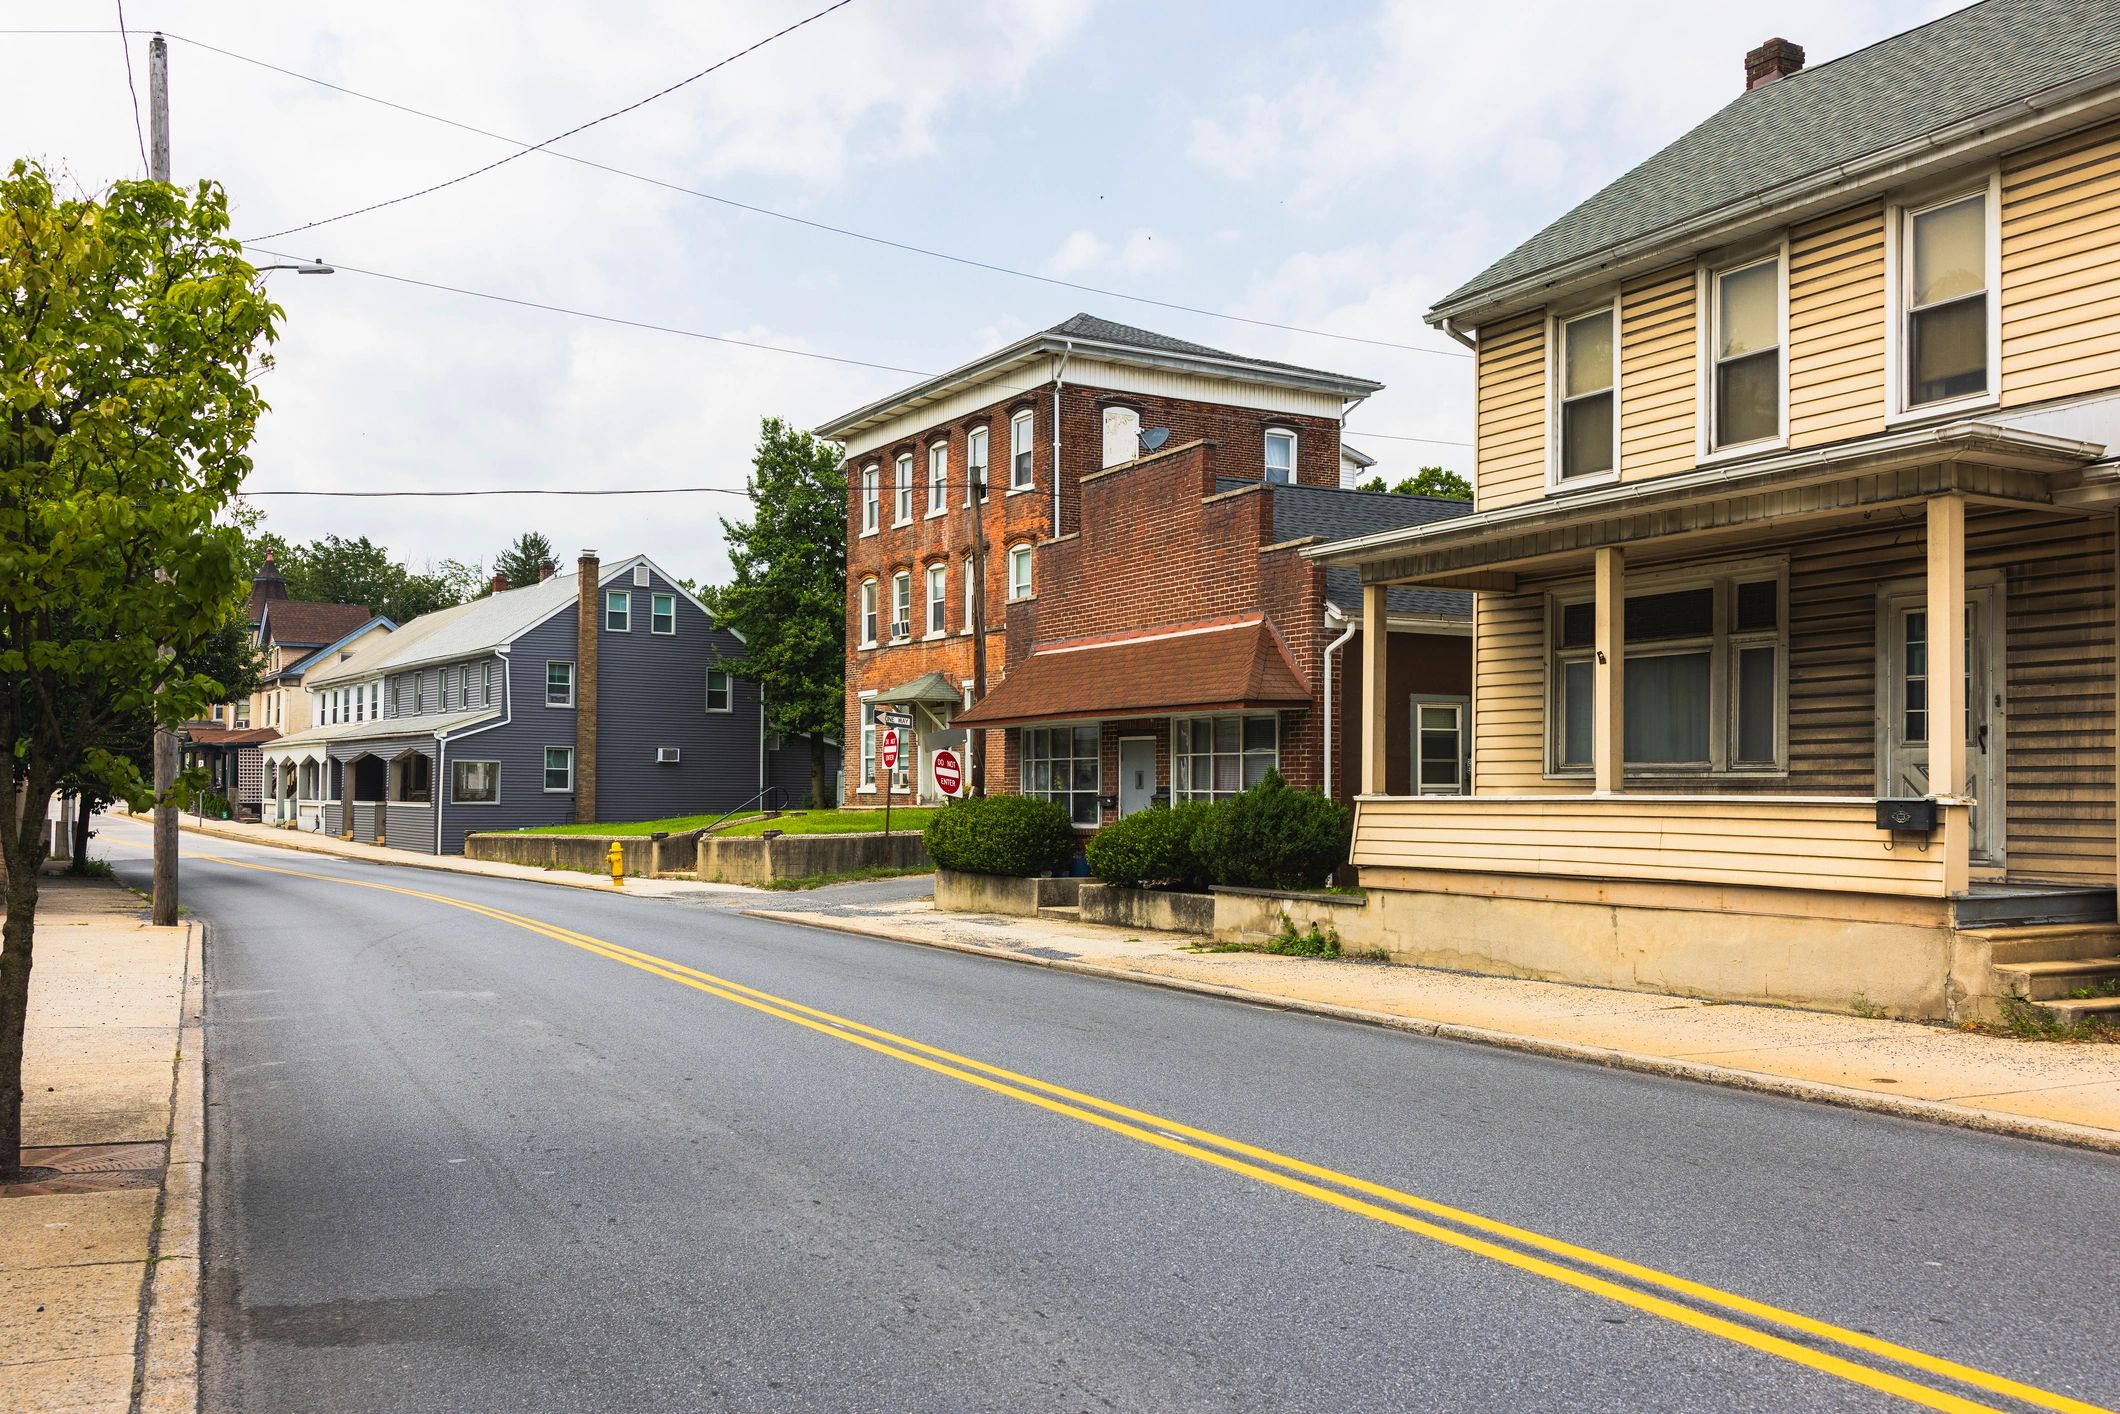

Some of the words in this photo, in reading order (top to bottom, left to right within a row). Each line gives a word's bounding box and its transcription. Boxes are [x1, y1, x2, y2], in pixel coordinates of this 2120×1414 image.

[885, 715, 894, 723] ONE
[947, 760, 956, 768] NOT
[941, 777, 956, 787] ENTER
